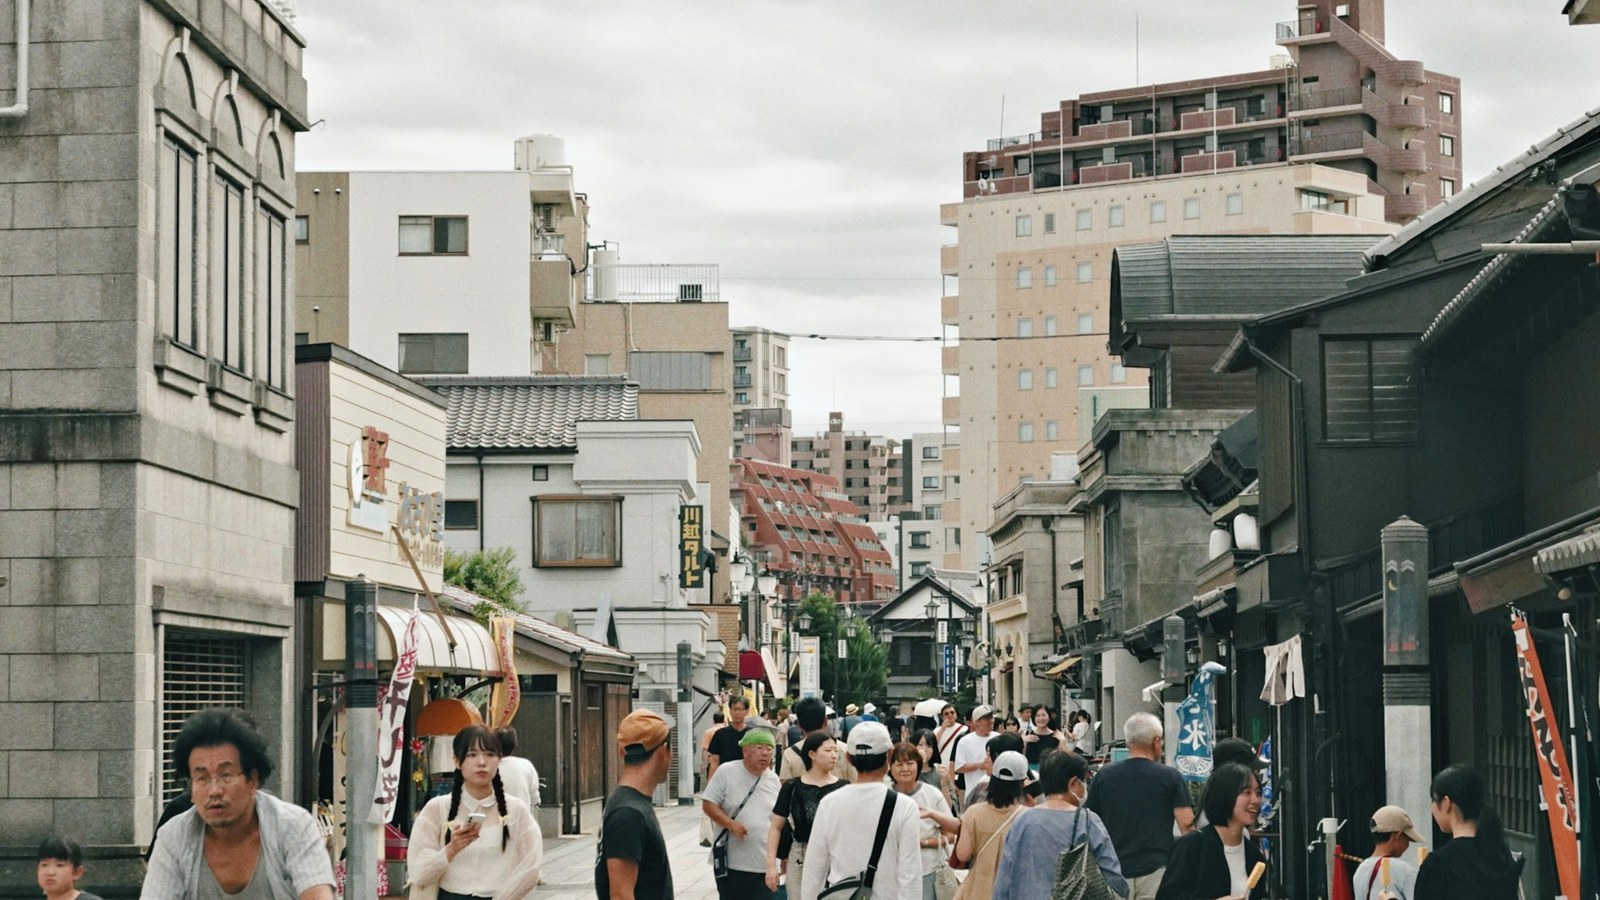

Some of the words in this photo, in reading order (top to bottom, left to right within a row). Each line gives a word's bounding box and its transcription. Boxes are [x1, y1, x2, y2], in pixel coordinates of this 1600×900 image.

[682, 507, 701, 586] 川越タルト
